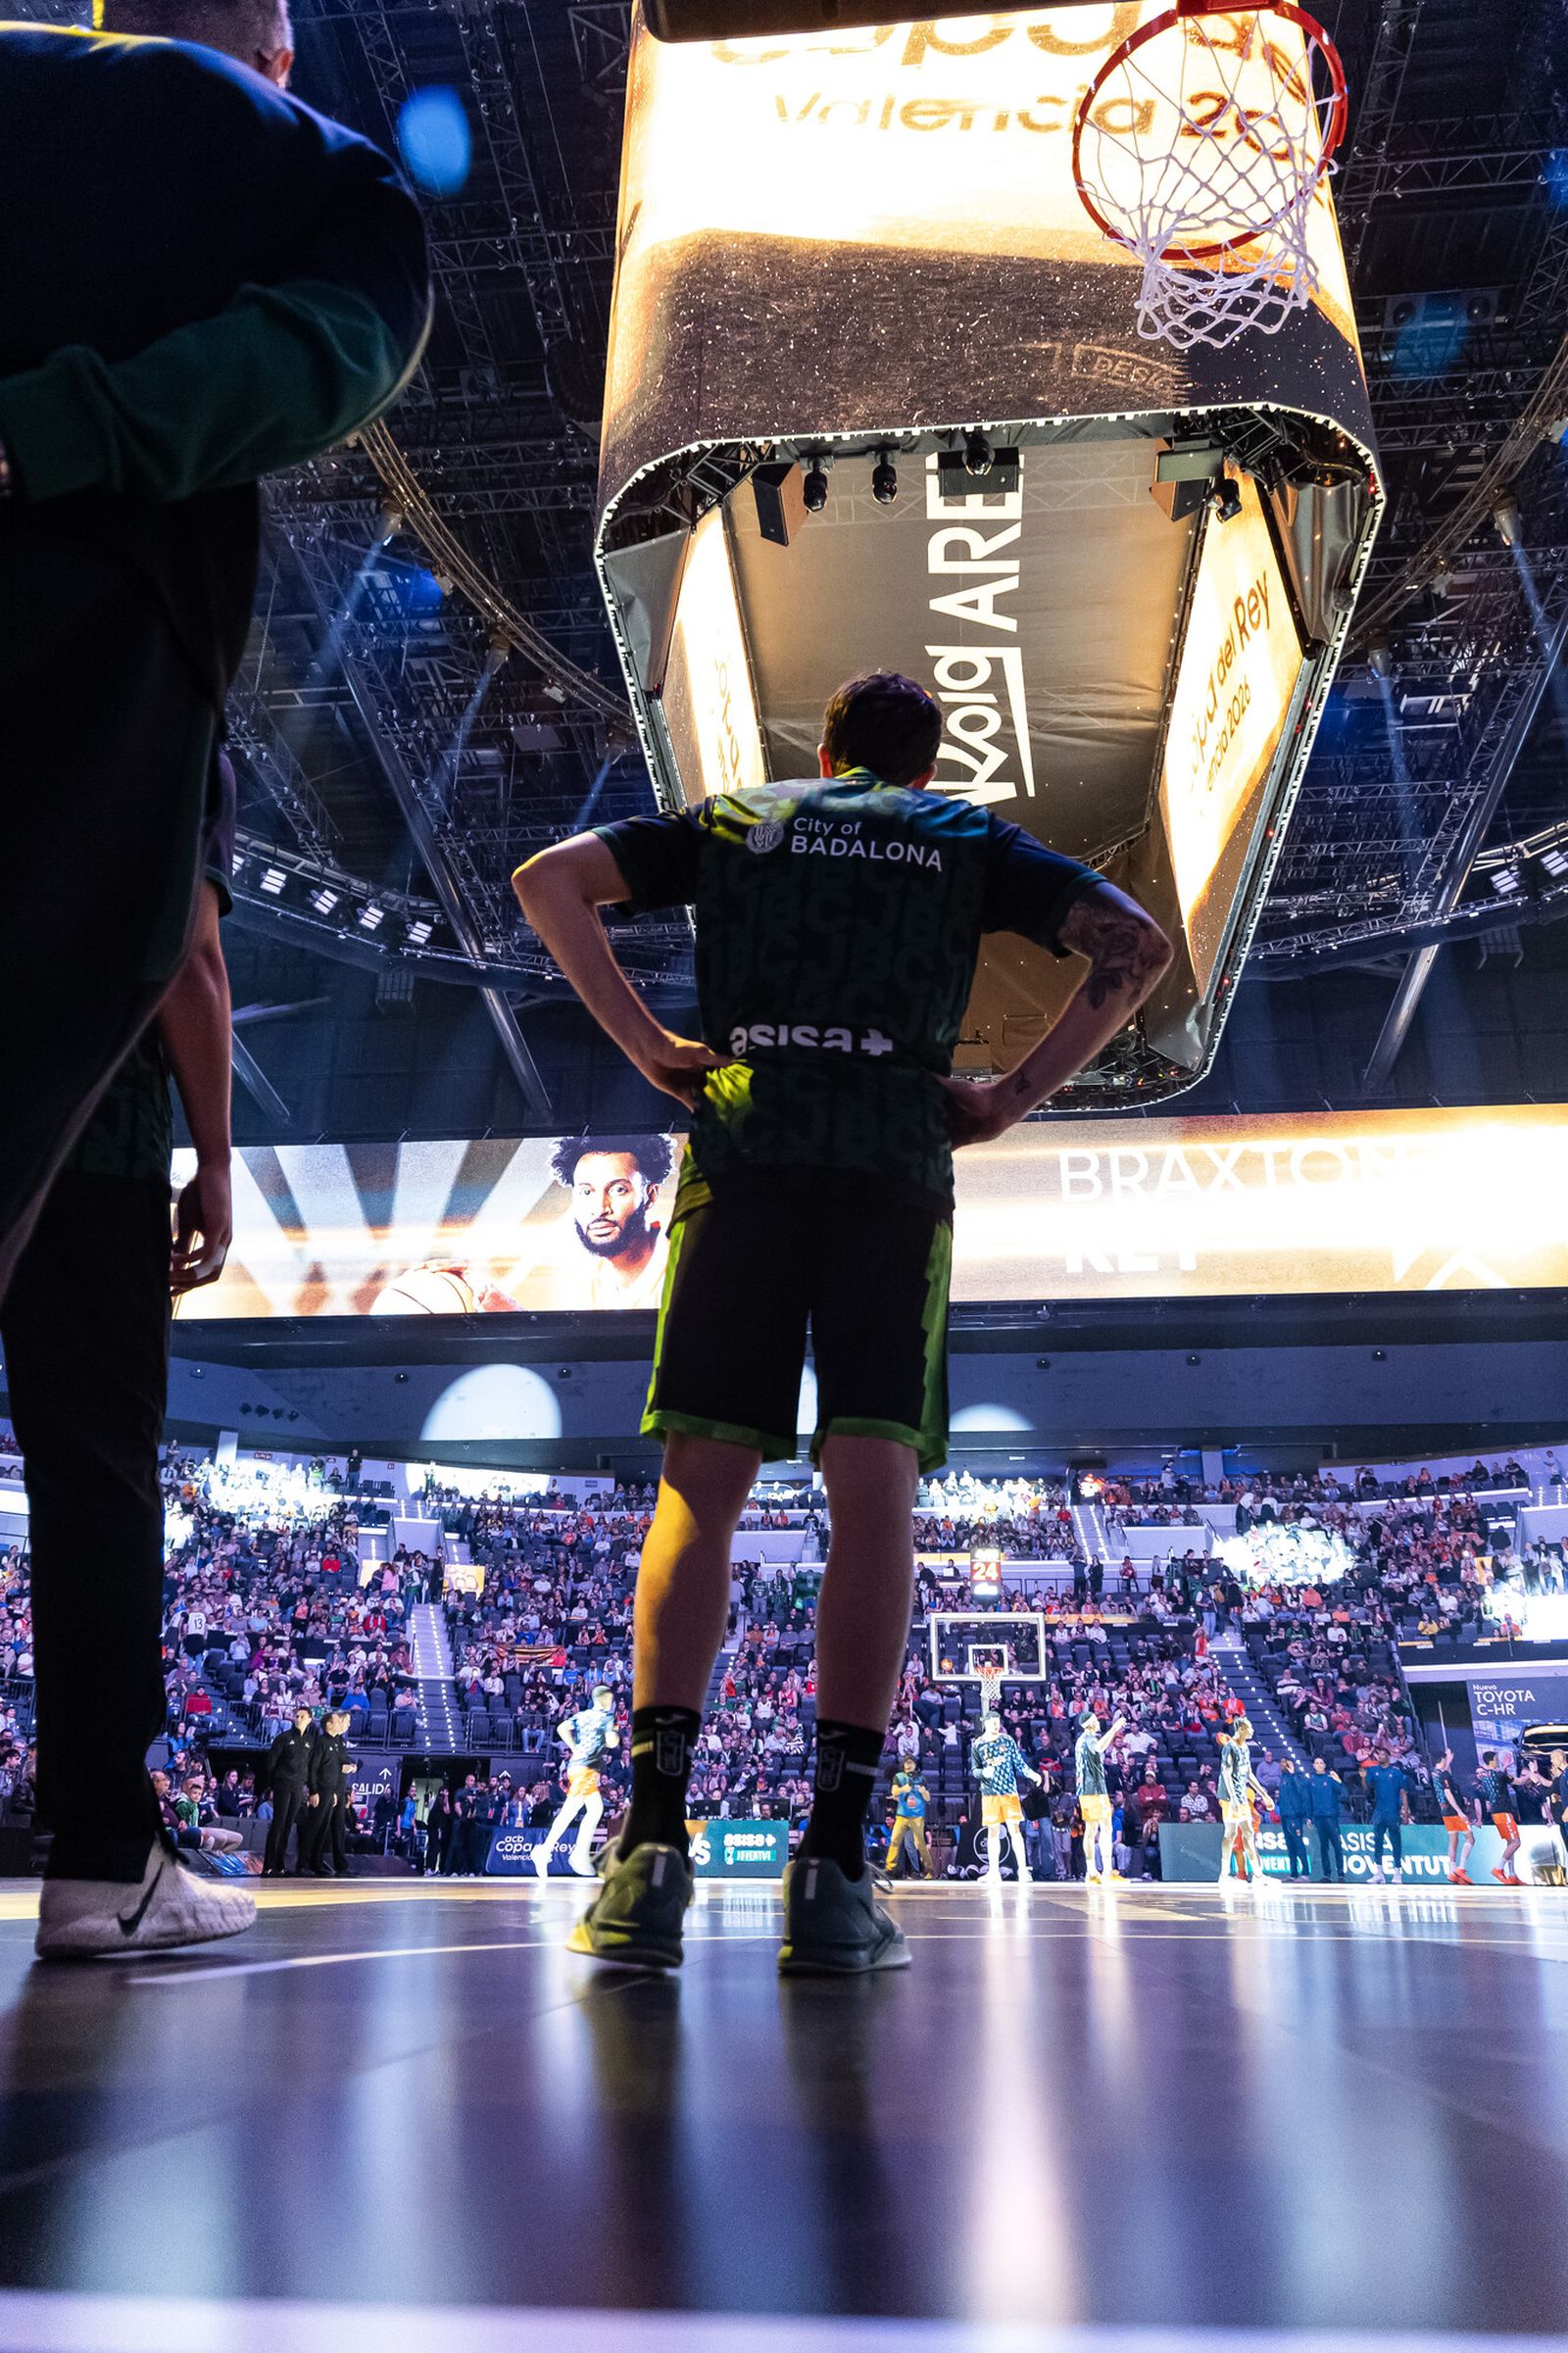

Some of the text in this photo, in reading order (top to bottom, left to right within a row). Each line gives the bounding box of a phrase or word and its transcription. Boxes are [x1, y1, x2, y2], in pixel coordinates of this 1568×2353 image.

[774, 84, 1157, 135] Valencia
[1234, 569, 1271, 651] Rey
[1226, 673, 1251, 739] 2026
[794, 817, 862, 836] City of
[791, 835, 942, 872] BADALONA
[1059, 1138, 1404, 1203] BRAXTON
[972, 1562, 999, 1581] 24
[1473, 1690, 1536, 1703] TOYOTA
[1476, 1702, 1516, 1716] C-HR
[496, 1840, 532, 1856] Copa
